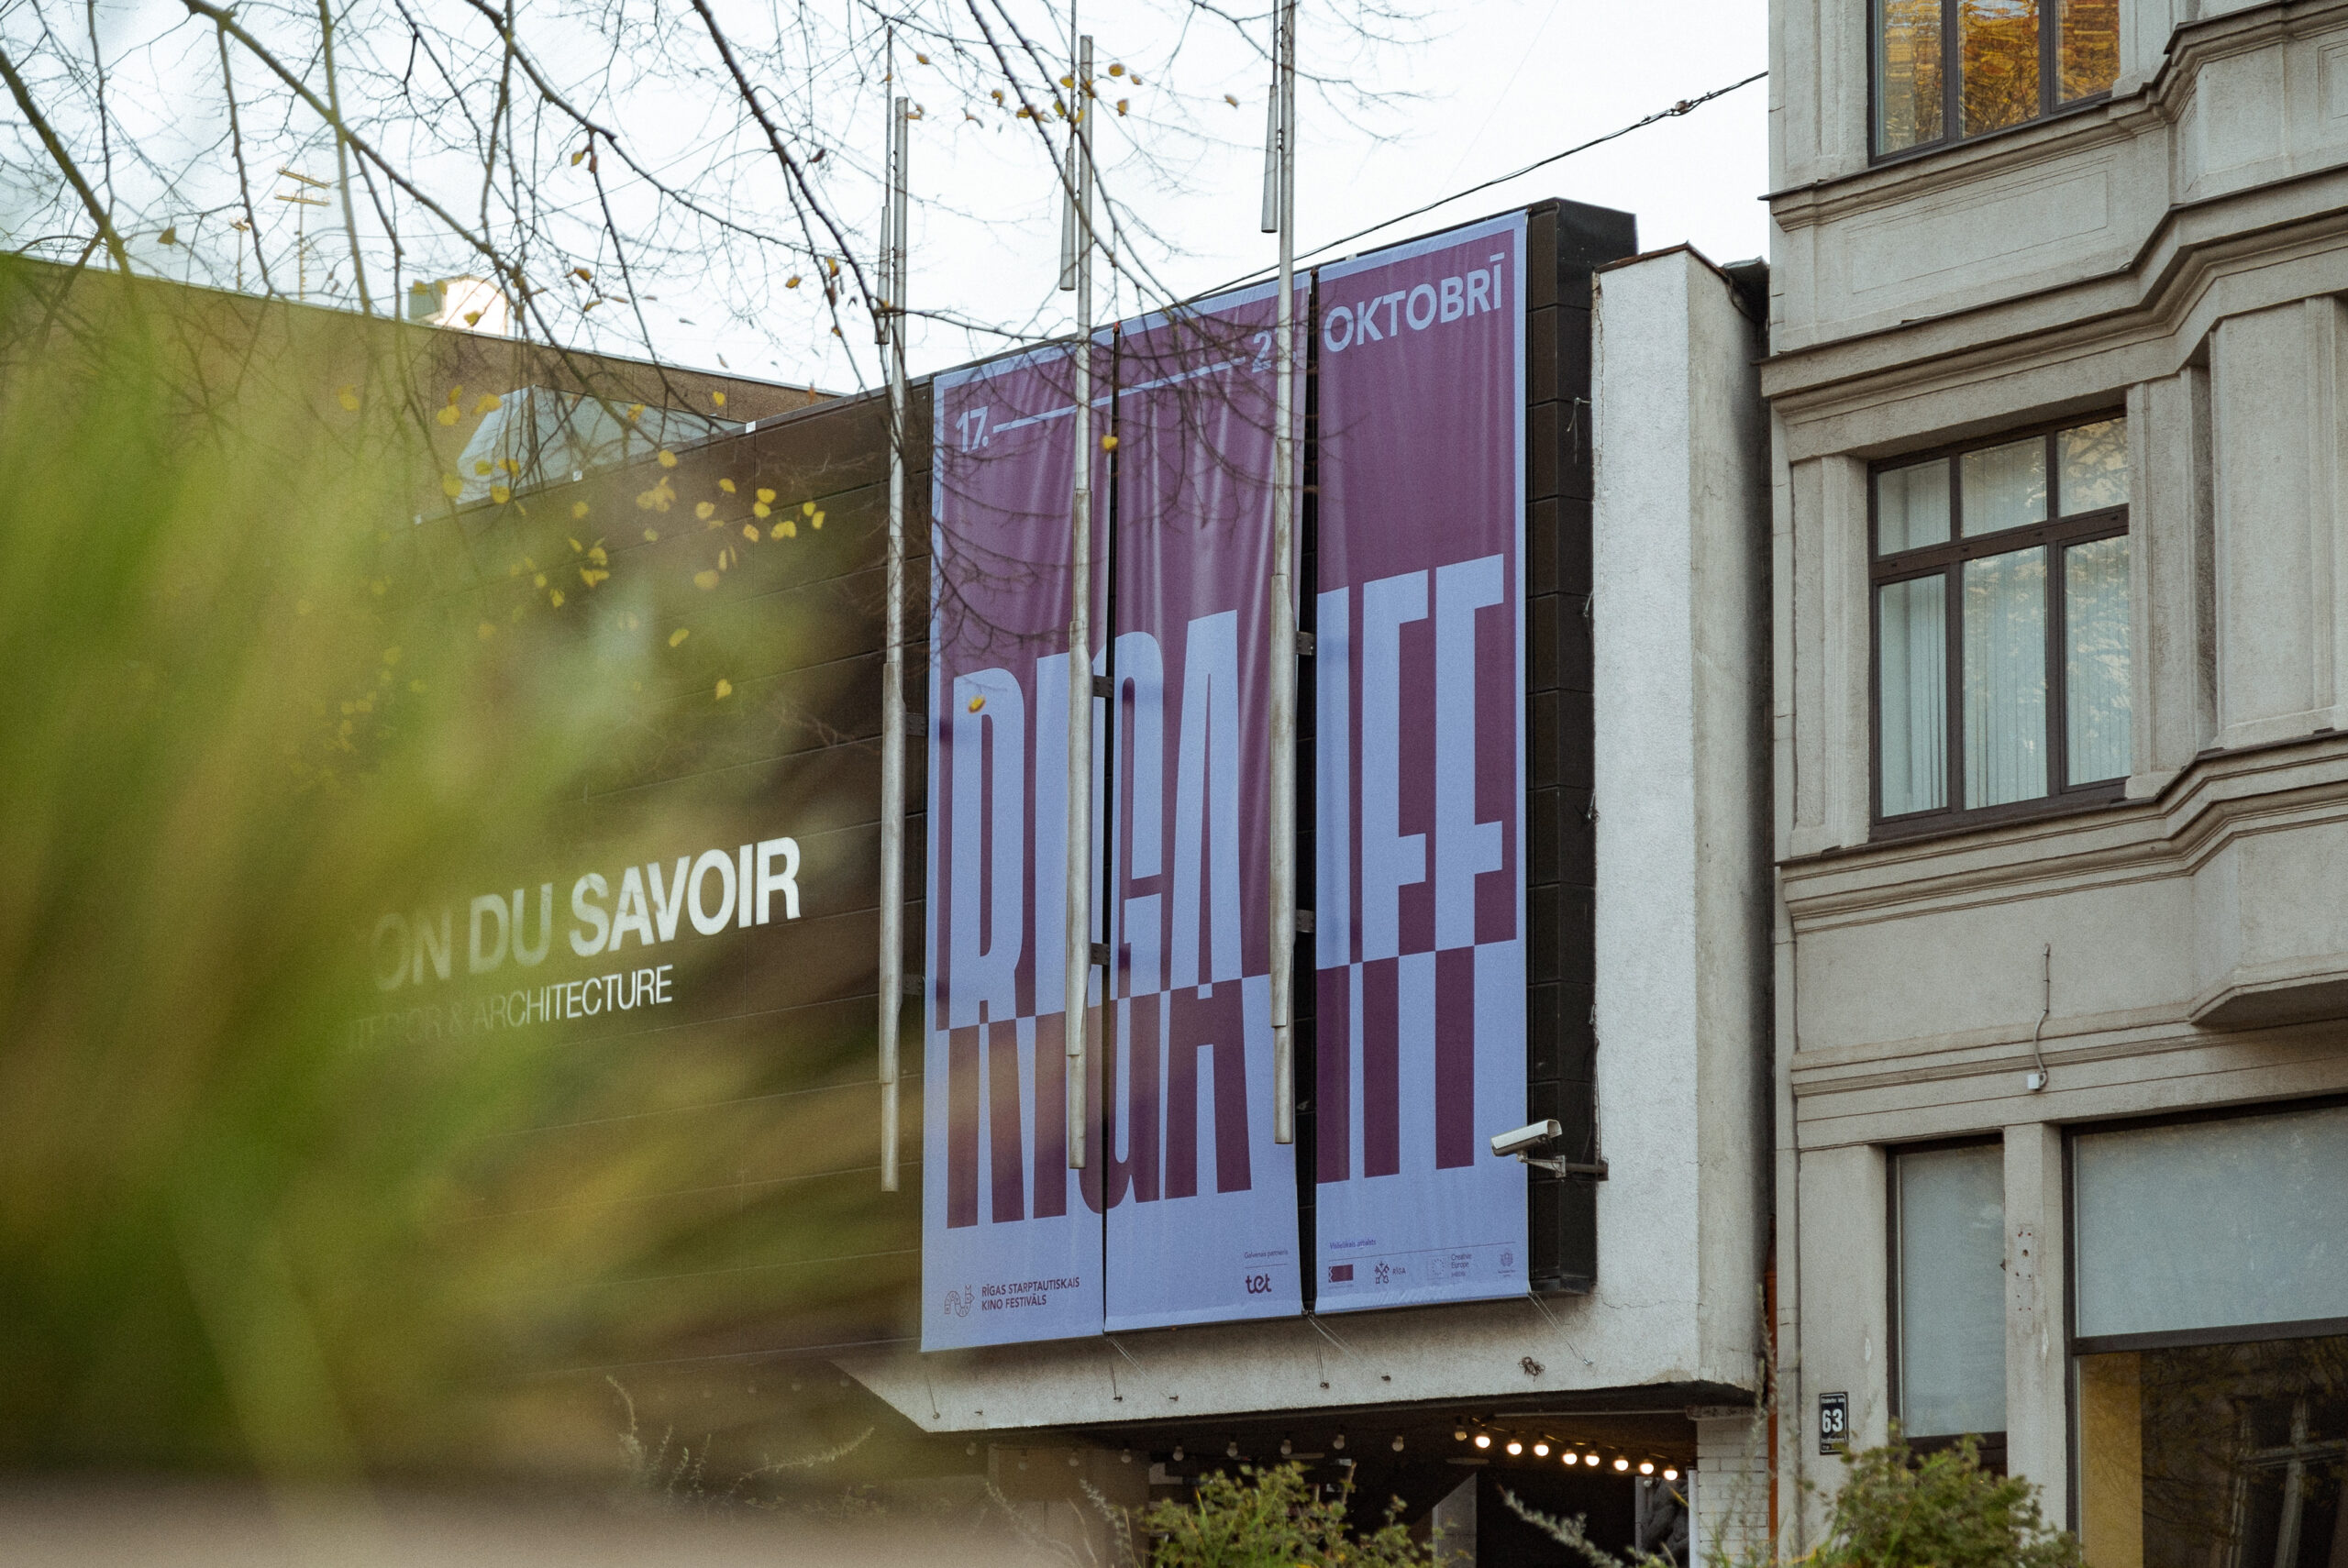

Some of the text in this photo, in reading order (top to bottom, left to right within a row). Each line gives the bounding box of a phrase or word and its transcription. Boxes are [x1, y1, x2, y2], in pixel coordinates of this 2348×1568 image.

[1324, 252, 1505, 352] OKTOBRĪ
[469, 882, 553, 975] DU
[569, 836, 802, 956] SAVOIR
[471, 965, 673, 1033] ARCHITECTURE
[981, 1276, 1080, 1297] RĪGAS STARPTAUTISKAIS
[1246, 1274, 1272, 1294] tet
[981, 1293, 1047, 1310] KINO FESTIVĀLS
[1822, 1408, 1843, 1433] 63
